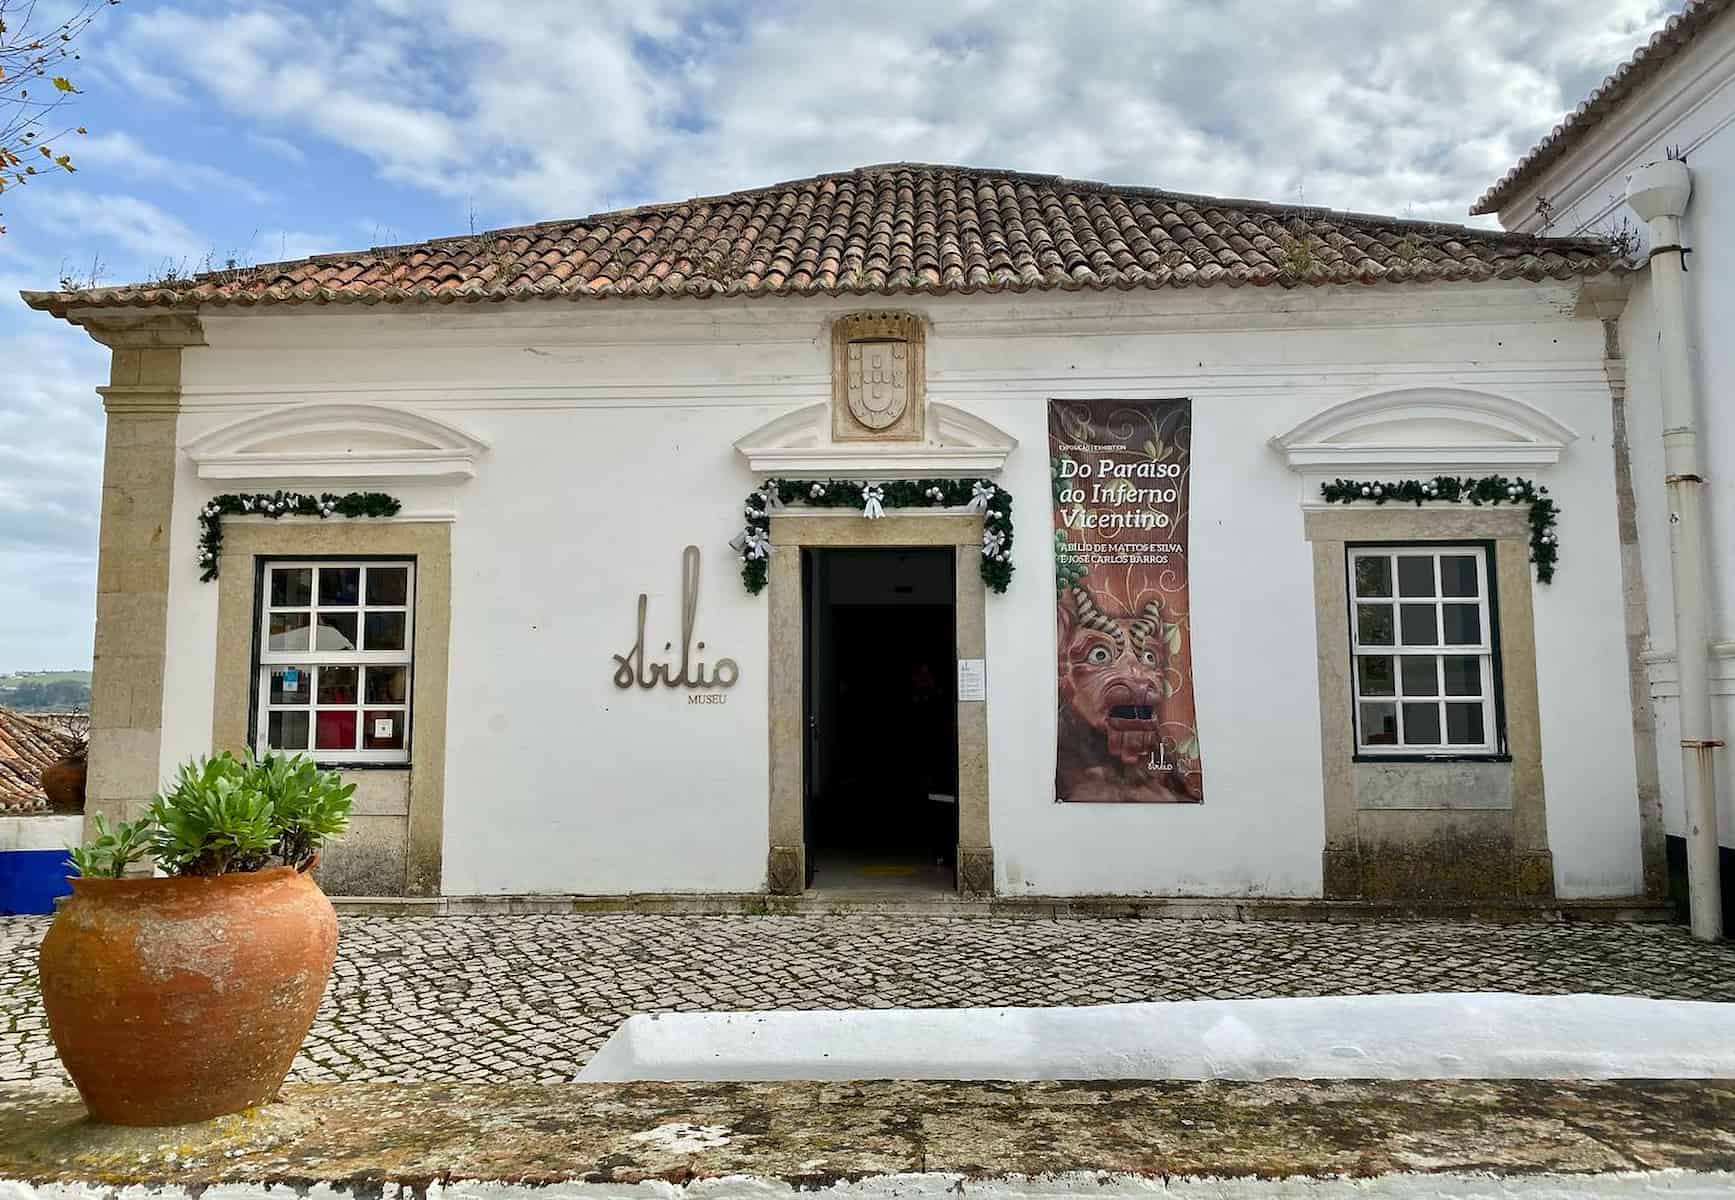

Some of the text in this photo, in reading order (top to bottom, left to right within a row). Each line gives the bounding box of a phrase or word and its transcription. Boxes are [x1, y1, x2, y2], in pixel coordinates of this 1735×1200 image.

[1060, 459, 1092, 478] Do
[1060, 484, 1177, 507] ao Inferno
[1060, 508, 1169, 528] Vicentino
[1094, 543, 1108, 553] DE
[1108, 543, 1149, 552] MATTOS
[1150, 543, 1156, 552] E
[1156, 543, 1183, 552] SILVA
[1091, 555, 1129, 564] CARLOS
[1130, 554, 1169, 563] BARROS
[688, 694, 727, 705] MUSEU
